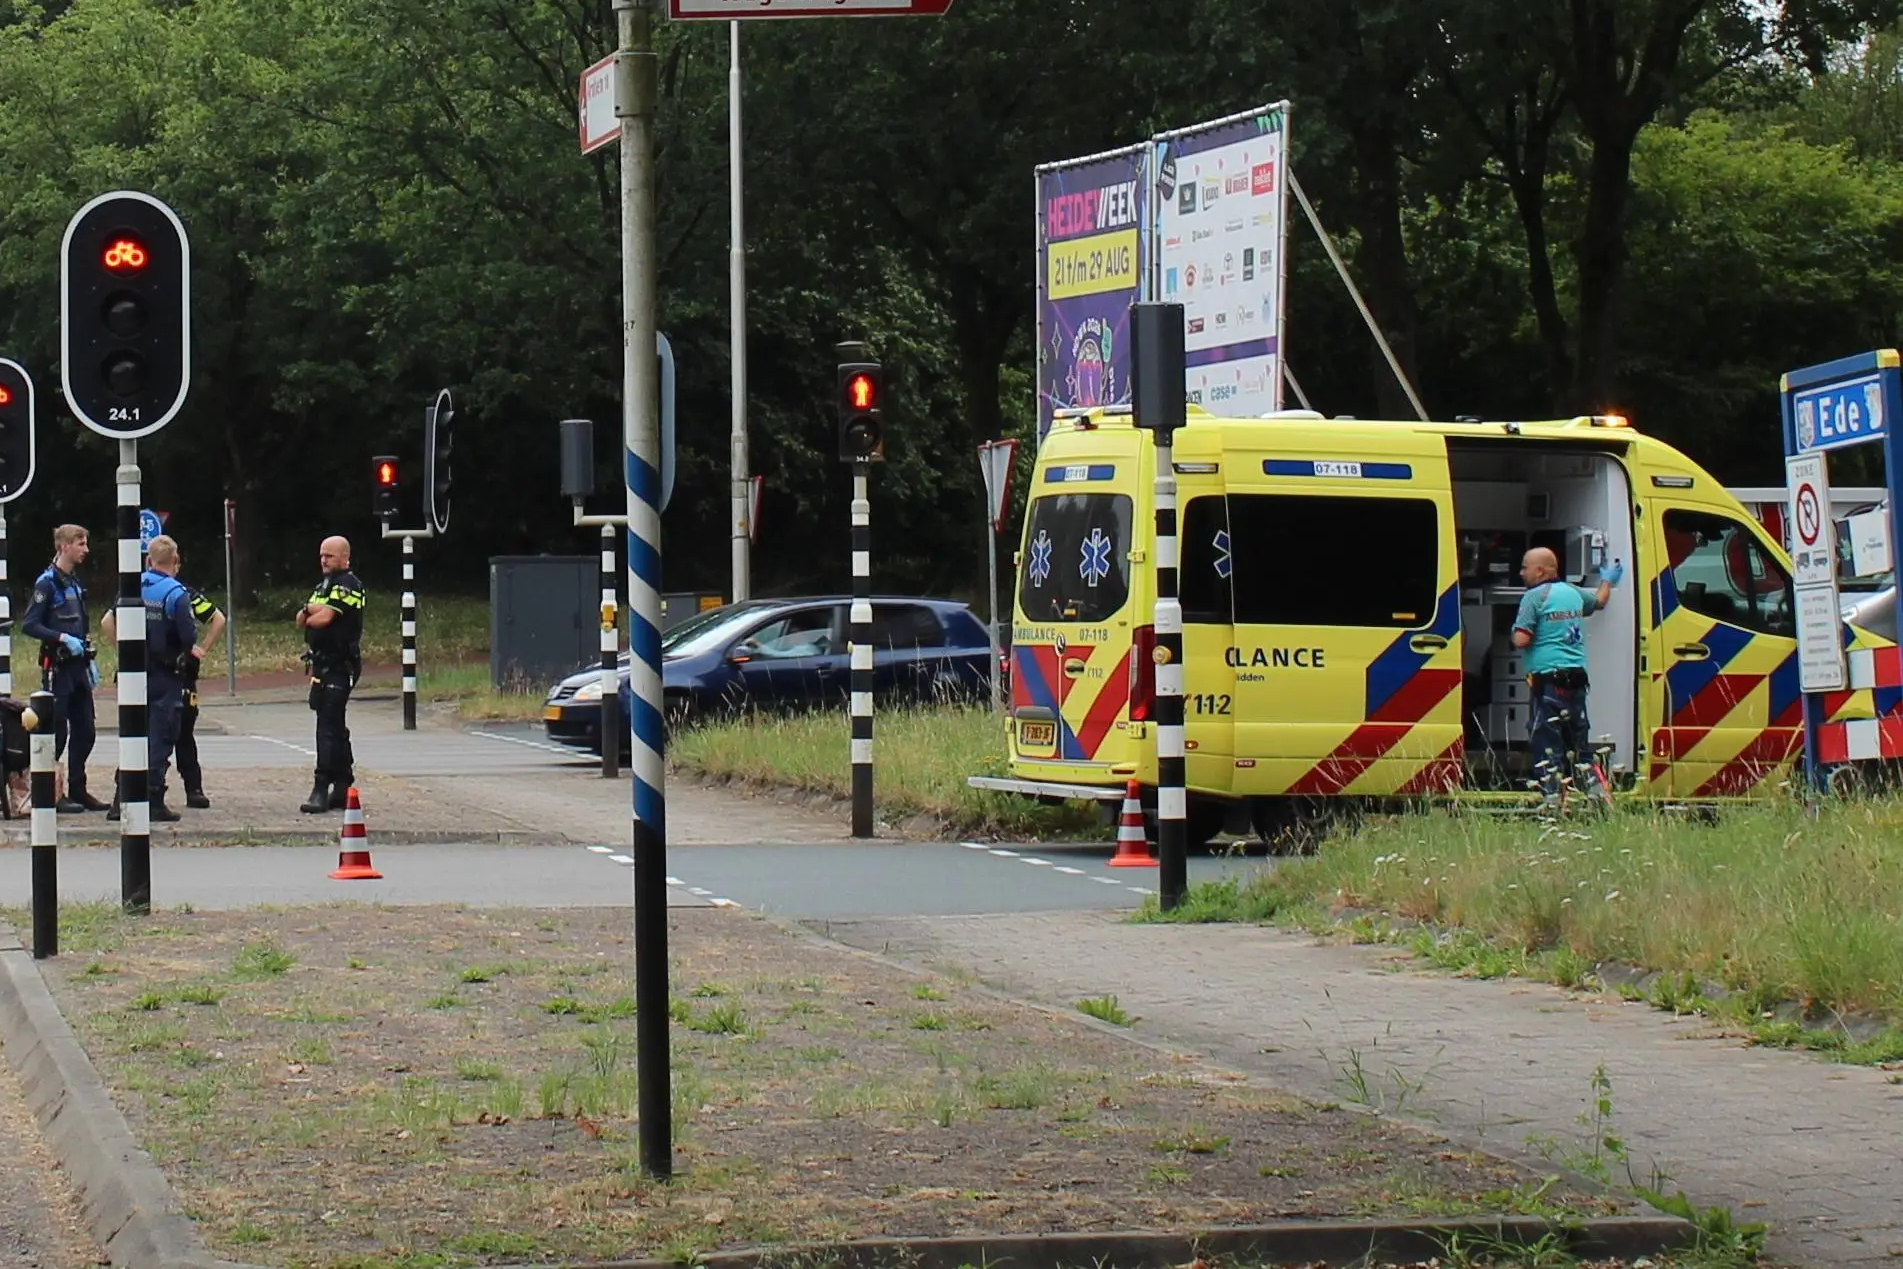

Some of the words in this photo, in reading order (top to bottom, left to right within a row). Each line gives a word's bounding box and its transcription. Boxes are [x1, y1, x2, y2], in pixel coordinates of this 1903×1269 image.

[1067, 251, 1087, 285] t/m
[1089, 249, 1103, 280] 29
[1105, 245, 1129, 277] AUG
[109, 408, 140, 421] 24.1
[1819, 394, 1860, 437] Ede
[1315, 463, 1358, 475] 07-118
[1013, 627, 1056, 641] AMBULANCE
[1079, 628, 1109, 641] 07-118
